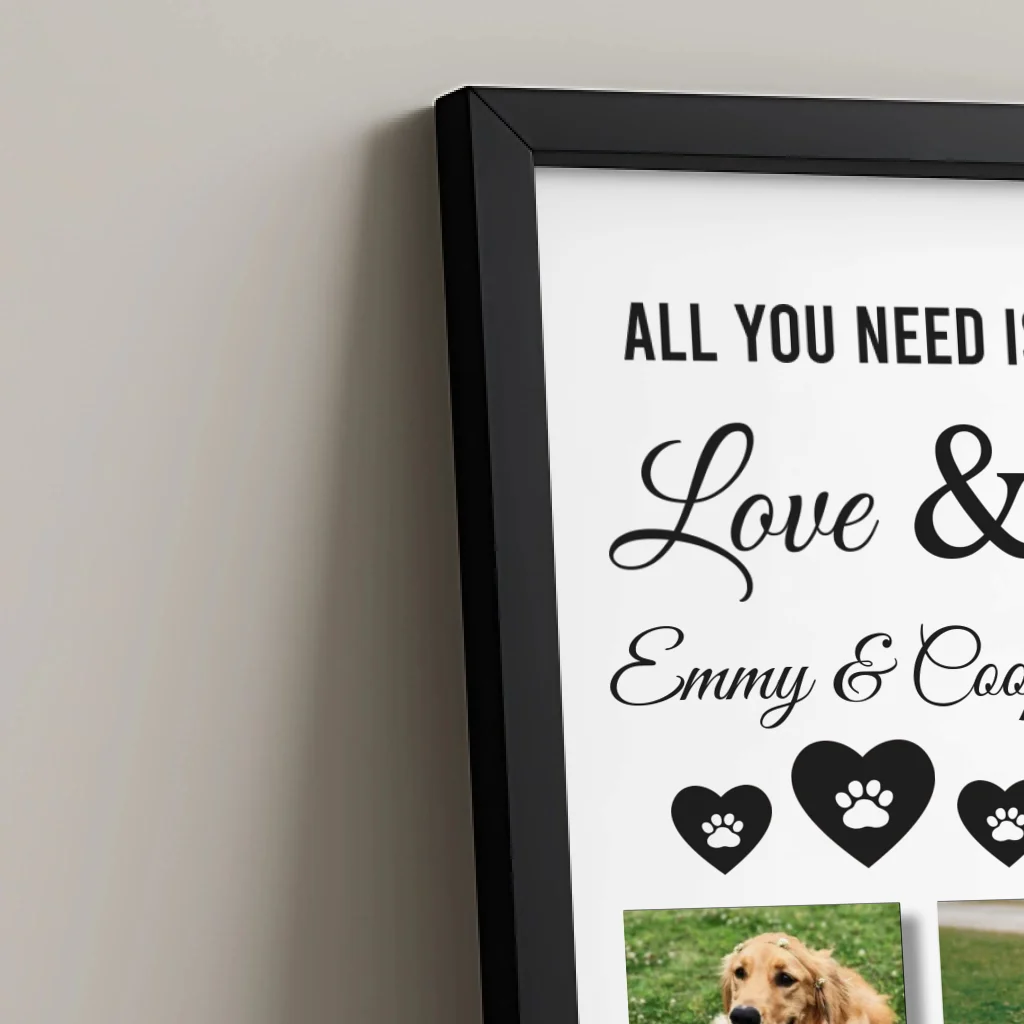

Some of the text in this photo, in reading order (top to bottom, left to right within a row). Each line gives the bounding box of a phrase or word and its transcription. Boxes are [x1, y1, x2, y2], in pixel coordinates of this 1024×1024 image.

[624, 302, 718, 362] ALL
[733, 303, 835, 364] YOU
[856, 305, 985, 365] NEED
[608, 422, 880, 603] Love
[609, 625, 817, 730] Emmy
[833, 632, 898, 703] &
